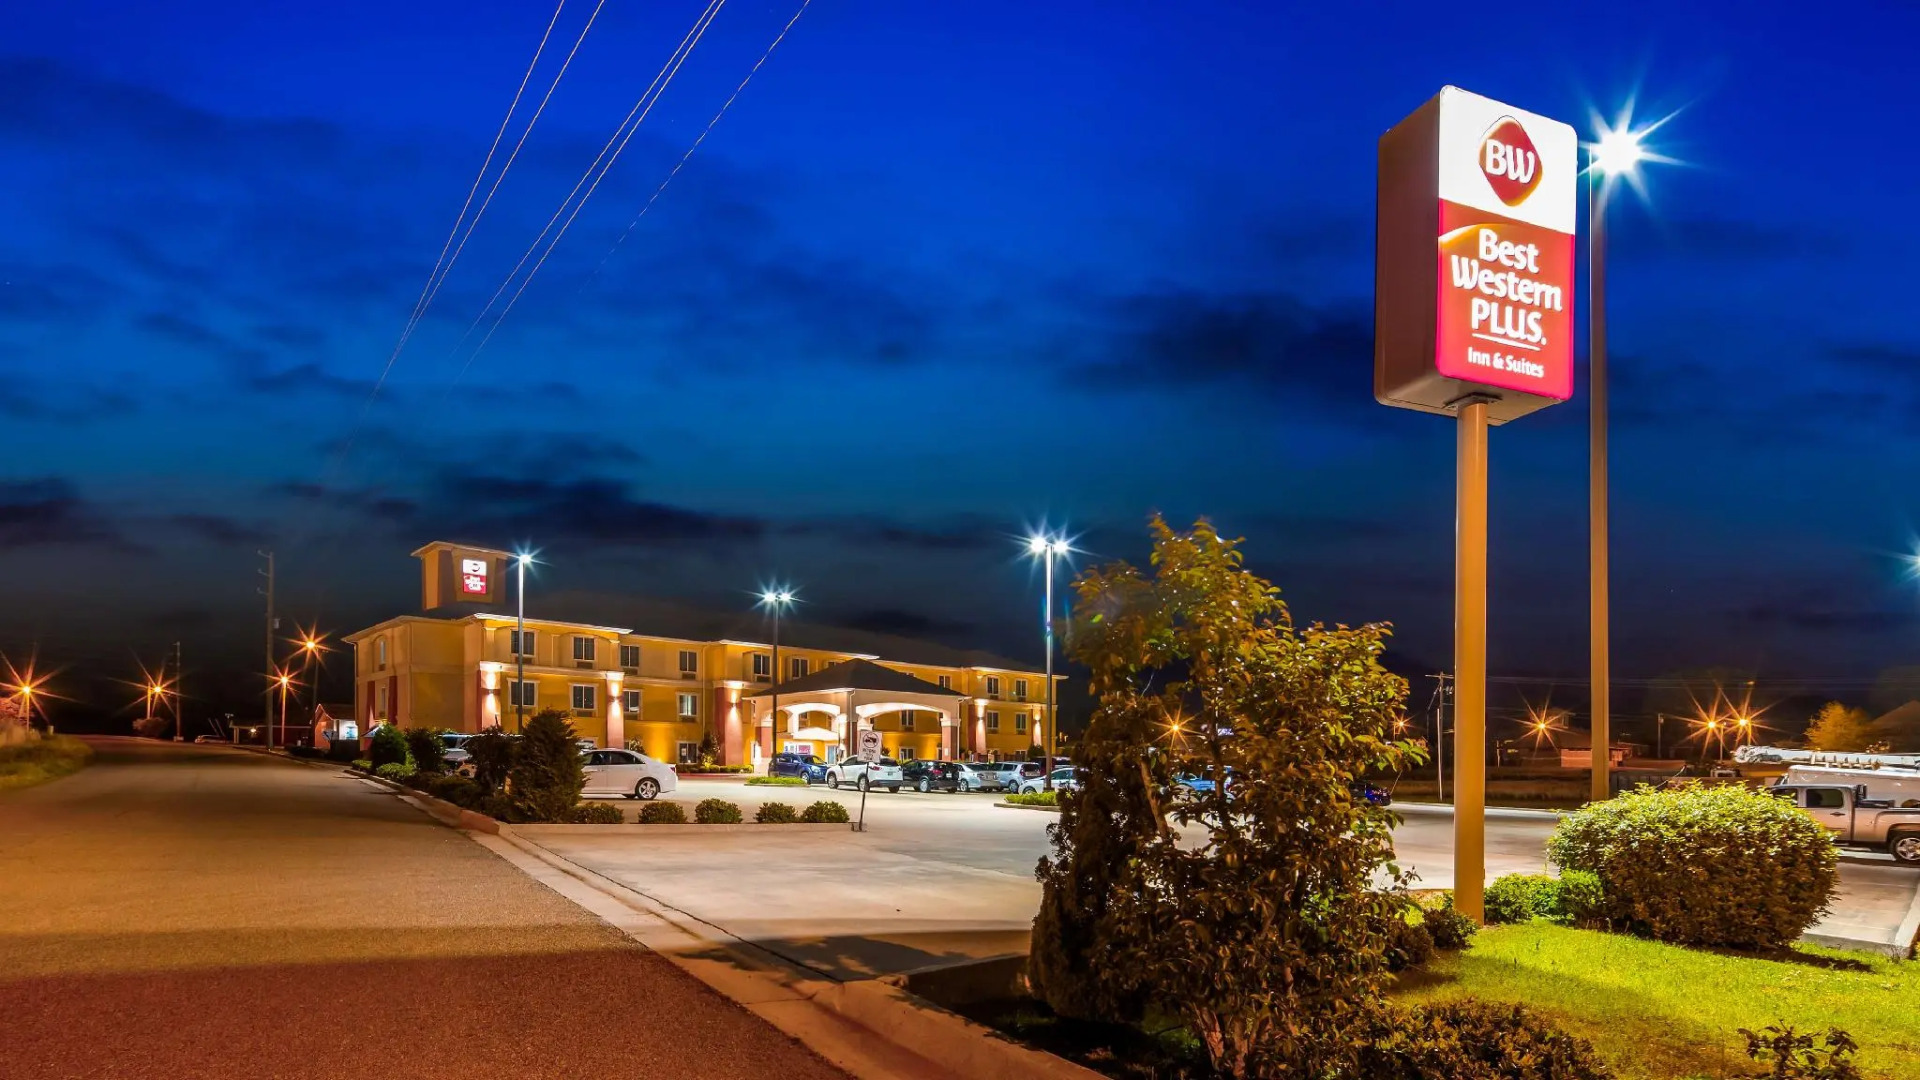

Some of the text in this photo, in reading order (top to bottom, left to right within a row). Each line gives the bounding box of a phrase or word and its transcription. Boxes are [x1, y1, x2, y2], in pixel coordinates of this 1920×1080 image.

[1485, 138, 1535, 184] BW
[1479, 228, 1540, 273] Best
[1451, 254, 1563, 312] Western
[1467, 346, 1545, 378] Inn & Suites
